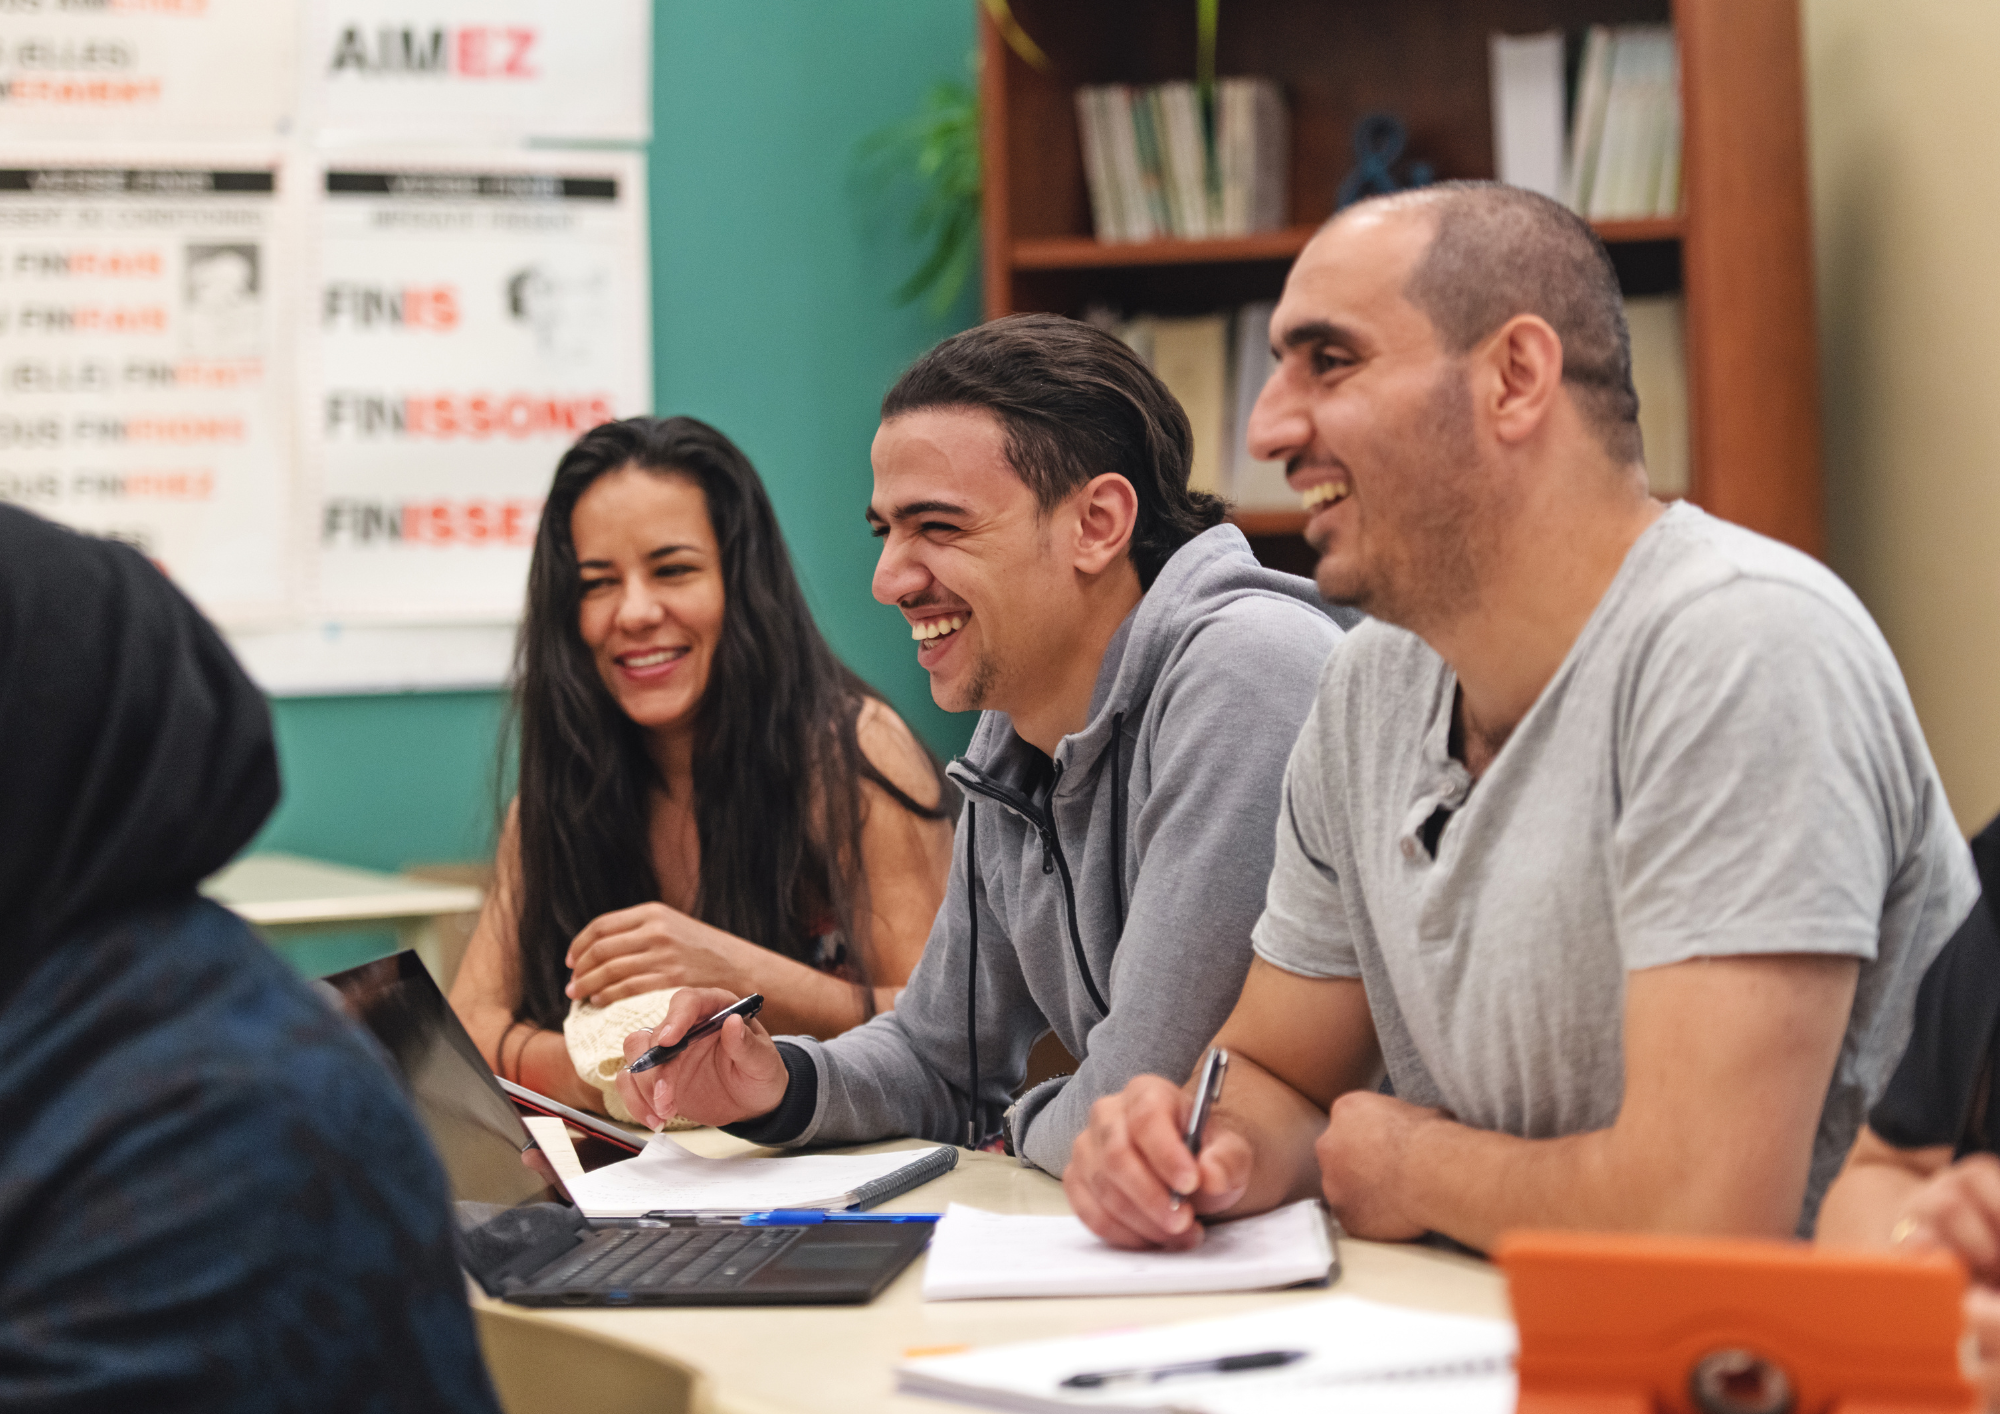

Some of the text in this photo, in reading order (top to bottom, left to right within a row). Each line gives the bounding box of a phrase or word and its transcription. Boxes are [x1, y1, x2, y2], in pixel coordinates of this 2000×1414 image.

[328, 27, 540, 78] AIMEZ
[324, 284, 460, 332] FINIS
[324, 499, 546, 547] FINISSE
